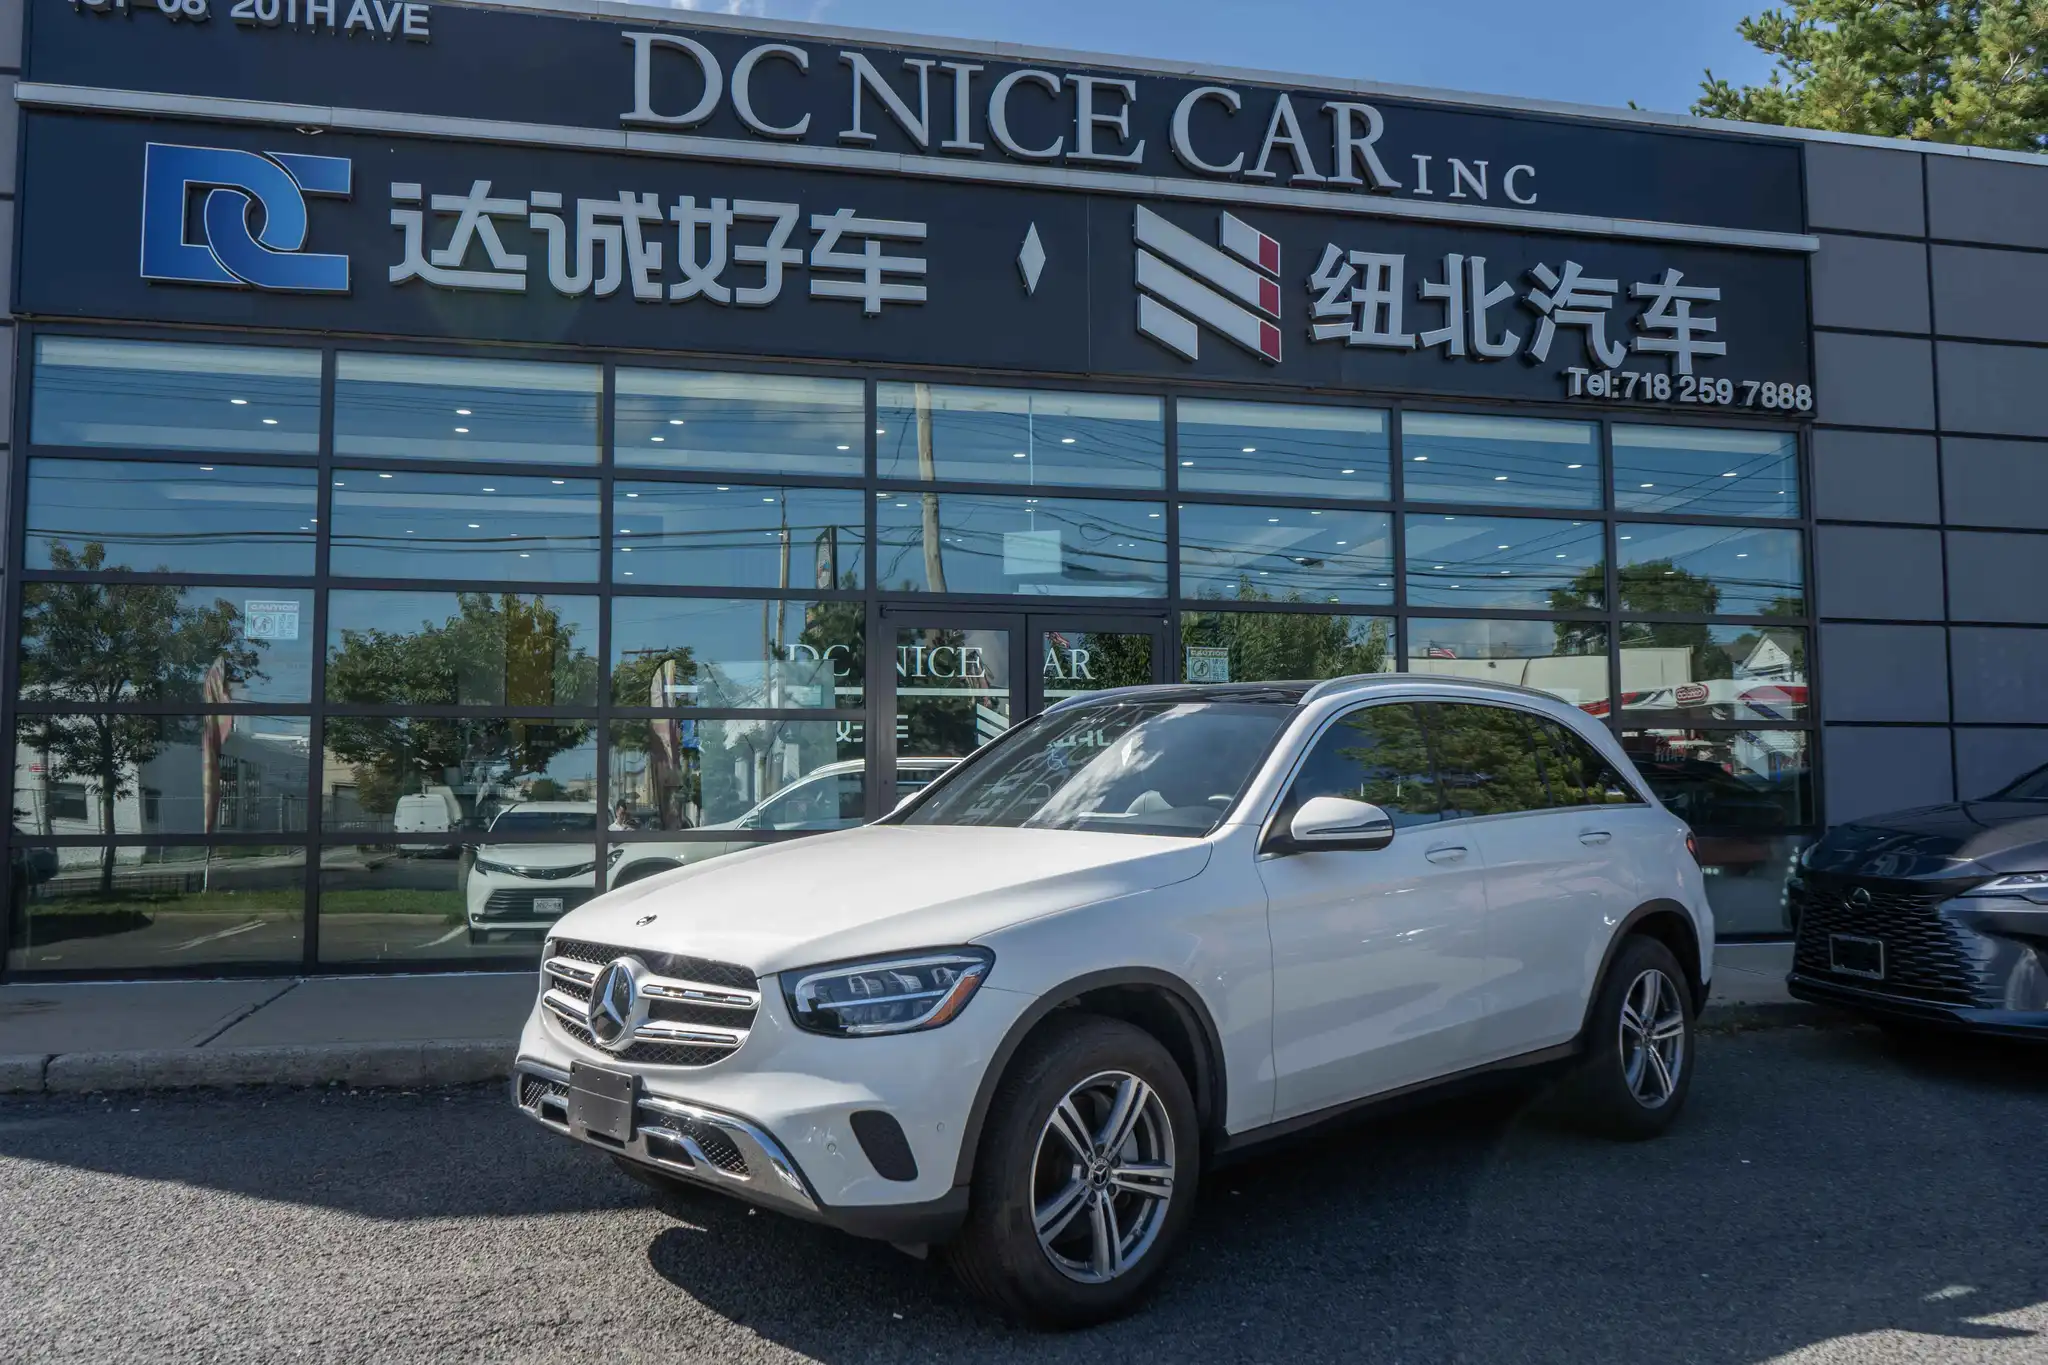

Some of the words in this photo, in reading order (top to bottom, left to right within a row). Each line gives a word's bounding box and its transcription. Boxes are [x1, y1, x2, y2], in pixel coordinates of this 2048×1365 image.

[344, 0, 430, 36] AVE
[619, 31, 811, 138] DC
[838, 50, 1146, 165] NICE
[1168, 86, 1403, 192] CAR
[1411, 154, 1539, 205] INC
[389, 179, 928, 315] 达诚好车
[1309, 242, 1727, 375] 纽北汽车
[1679, 375, 1734, 405] 259
[1742, 380, 1813, 411] 7888
[1043, 649, 1096, 680] AR
